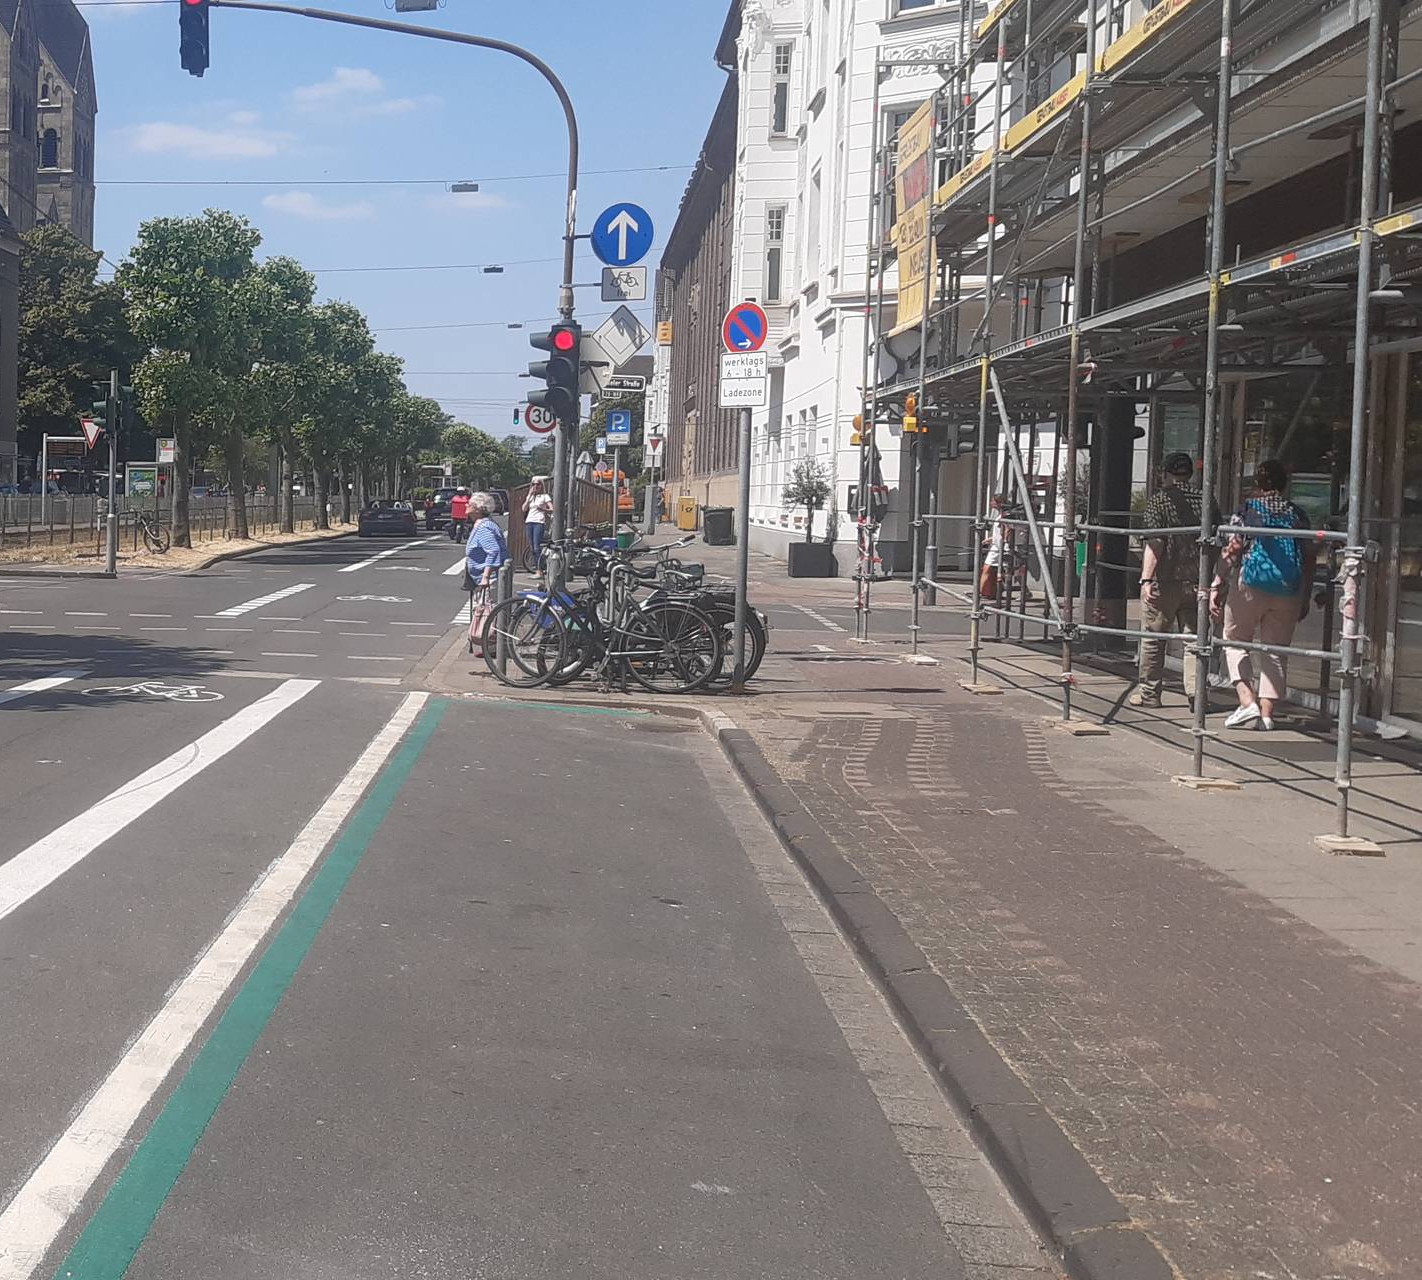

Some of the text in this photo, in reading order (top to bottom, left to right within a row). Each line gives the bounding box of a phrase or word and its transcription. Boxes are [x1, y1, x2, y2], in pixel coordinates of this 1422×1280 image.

[744, 368, 752, 377] 18
[756, 367, 761, 377] h
[723, 388, 763, 398] Ladezone
[532, 408, 552, 424] 30
[611, 413, 625, 431] P
